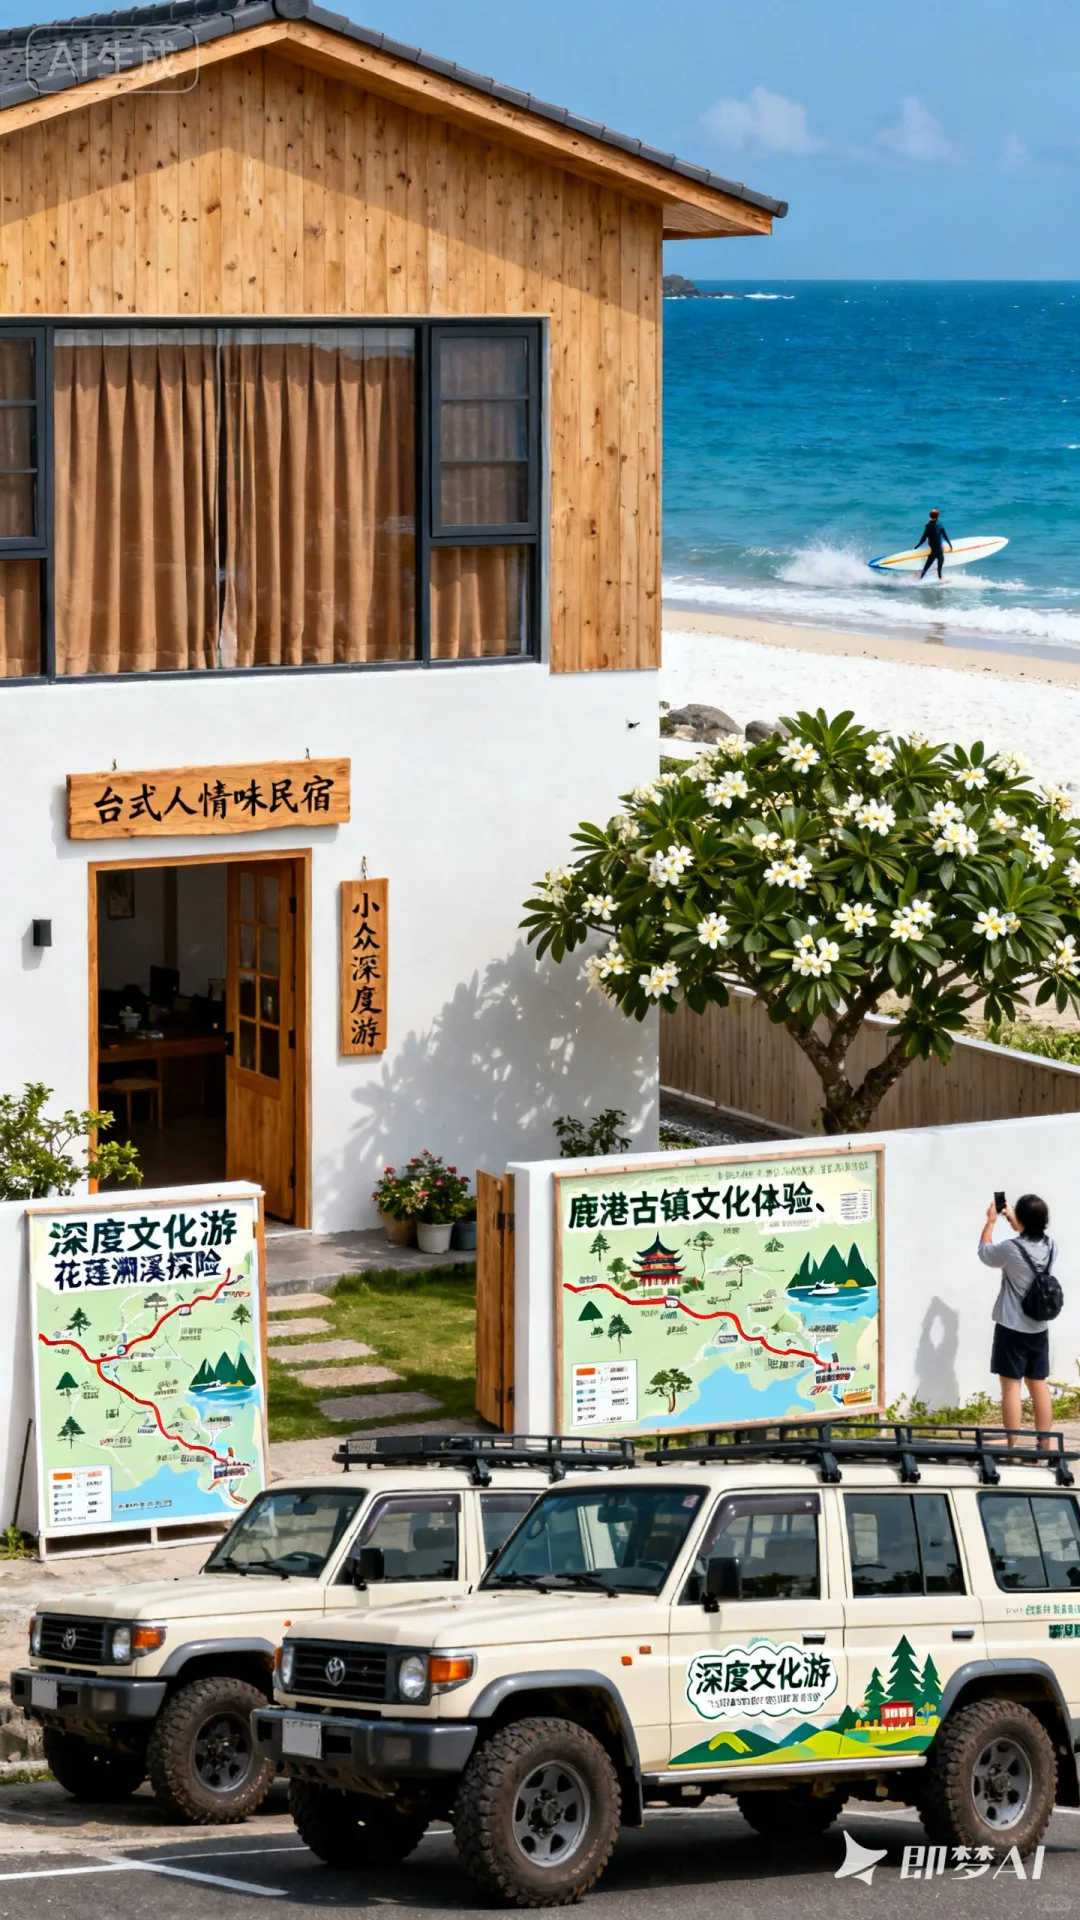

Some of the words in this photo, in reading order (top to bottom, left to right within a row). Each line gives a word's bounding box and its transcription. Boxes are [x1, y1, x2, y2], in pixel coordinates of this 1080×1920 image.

[93, 775, 334, 824] 台式人情味民宿
[351, 893, 381, 1047] 小众深度游
[48, 1209, 237, 1257] 深度文化游
[695, 1652, 831, 1695] 深度文化游
